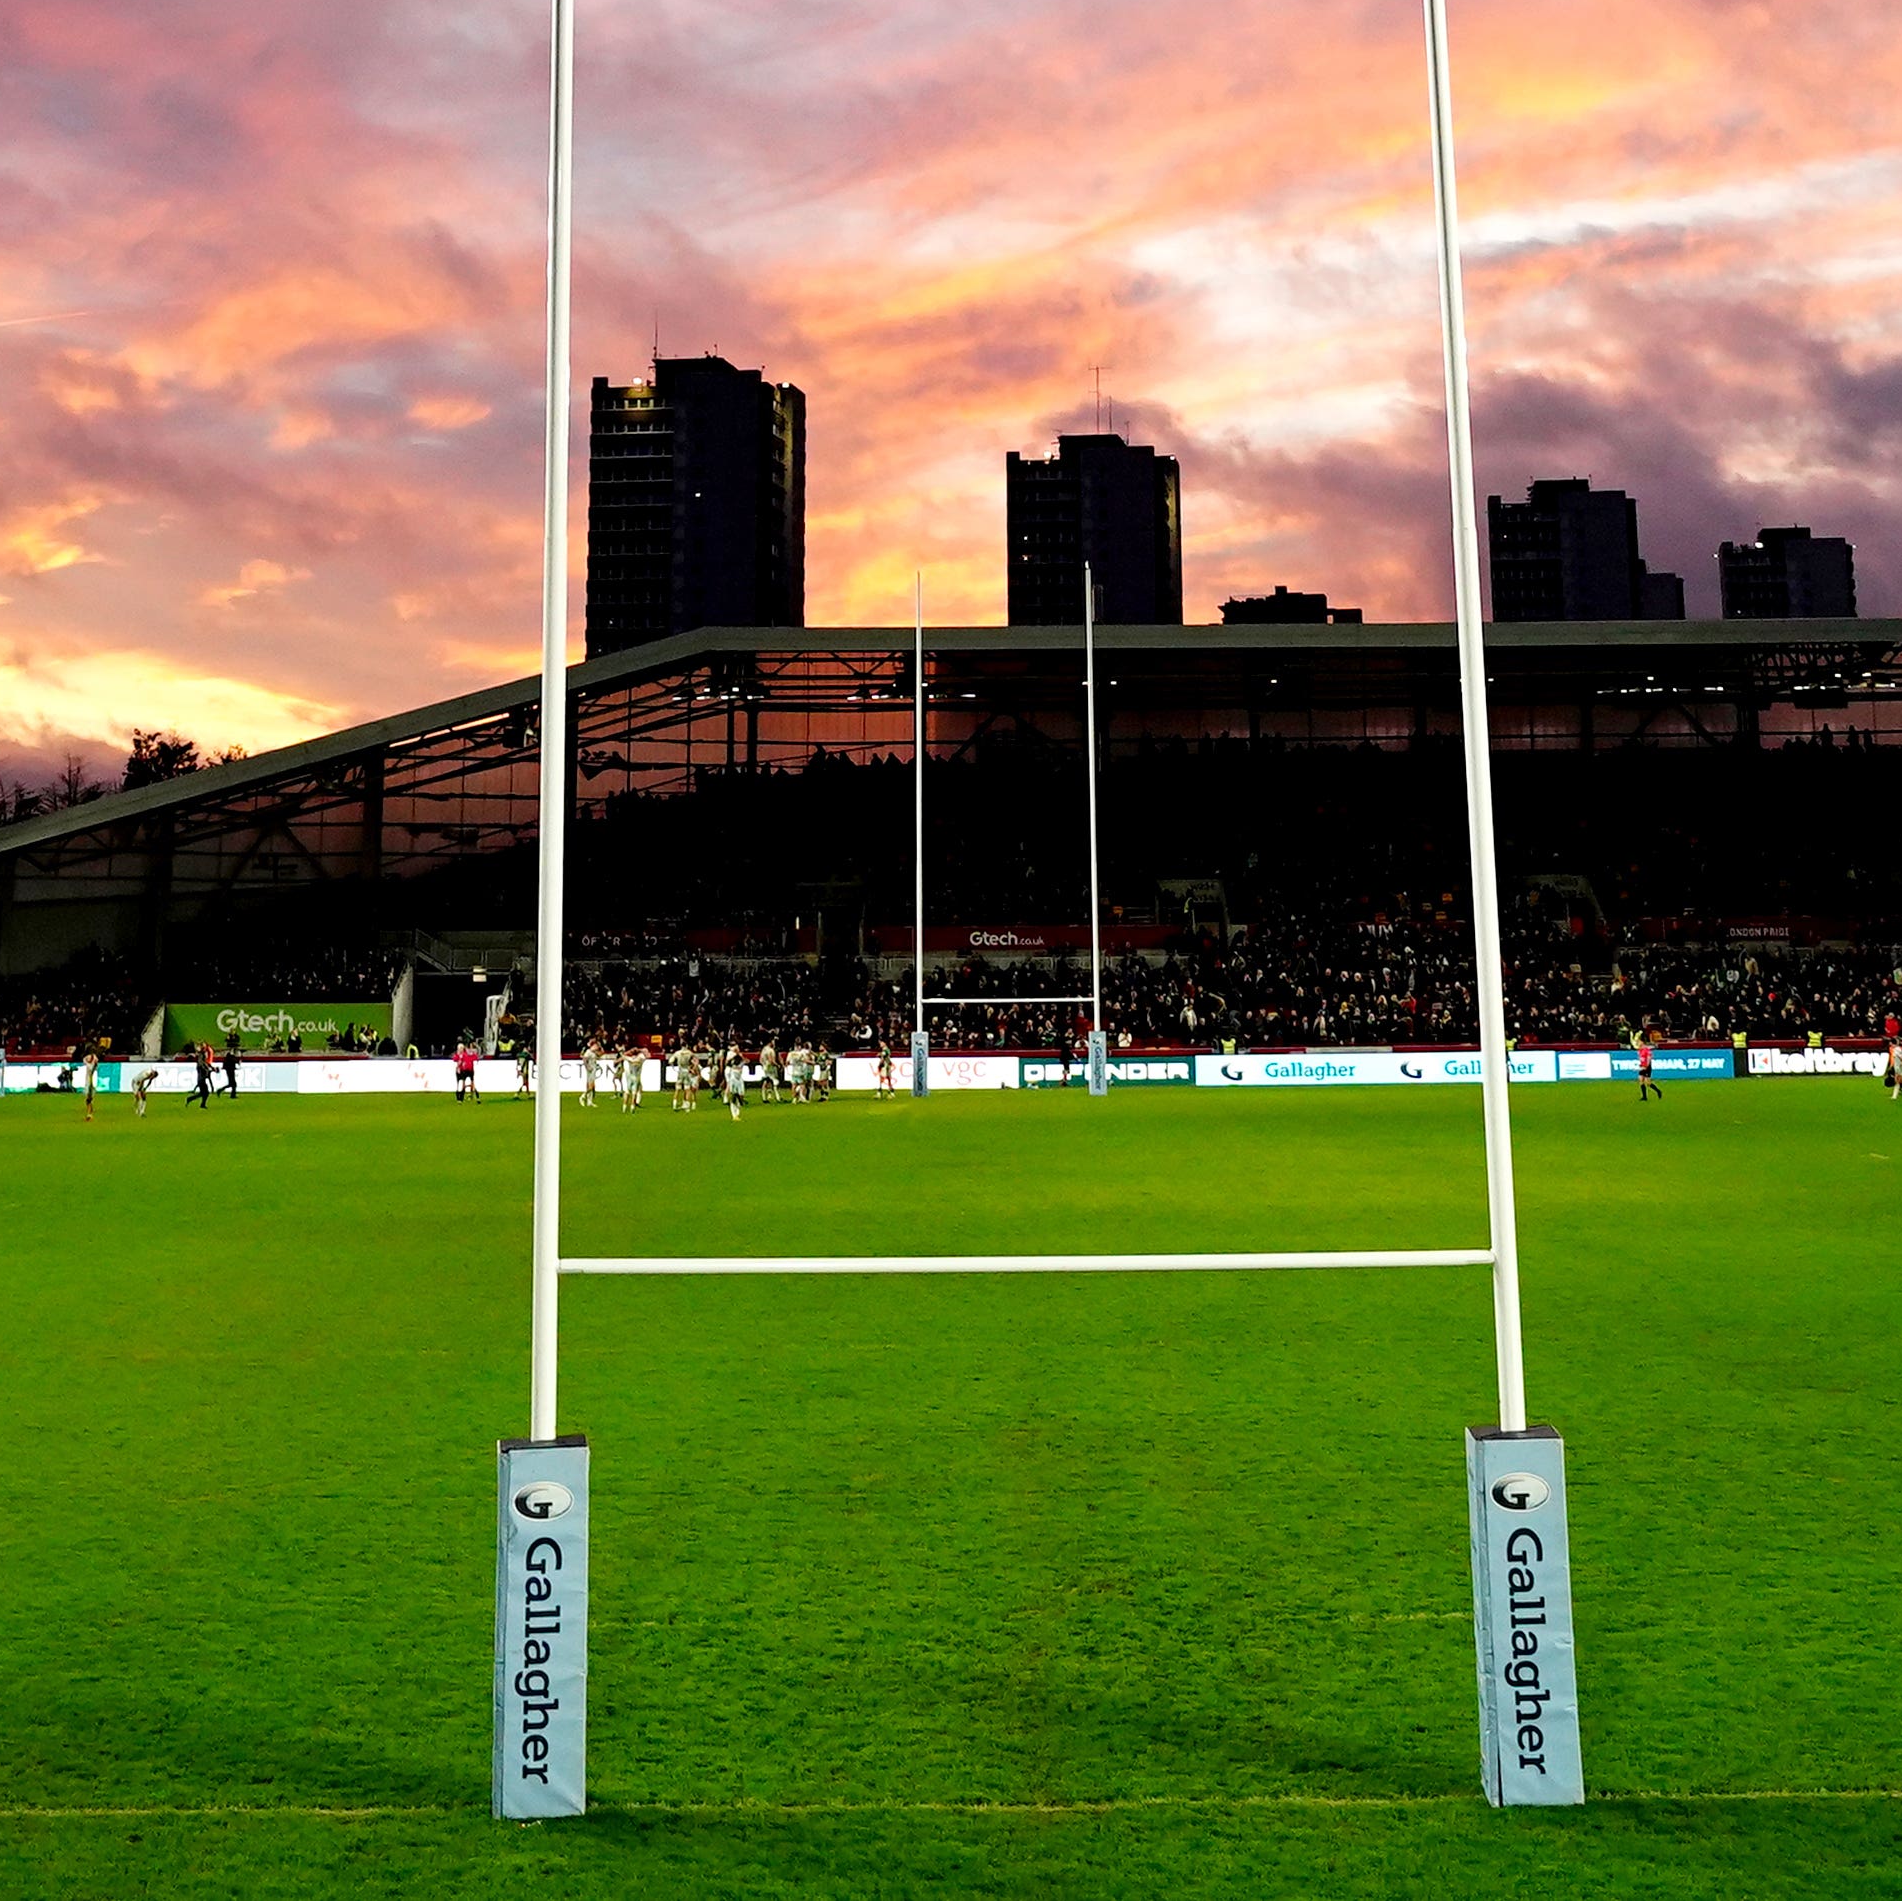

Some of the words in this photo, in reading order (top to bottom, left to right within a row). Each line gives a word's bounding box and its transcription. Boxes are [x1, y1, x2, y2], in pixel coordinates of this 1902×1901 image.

[969, 930, 1045, 947] Gtech.co.uk
[1728, 927, 1761, 937] ONDON
[1763, 927, 1790, 937] PRIDE
[216, 1009, 338, 1033] Gtech.co.uk
[943, 1061, 988, 1085] vgc
[1265, 1062, 1356, 1081] Gallagher
[514, 1536, 563, 1785] Gallagher
[1504, 1527, 1551, 1775] Gallagher
